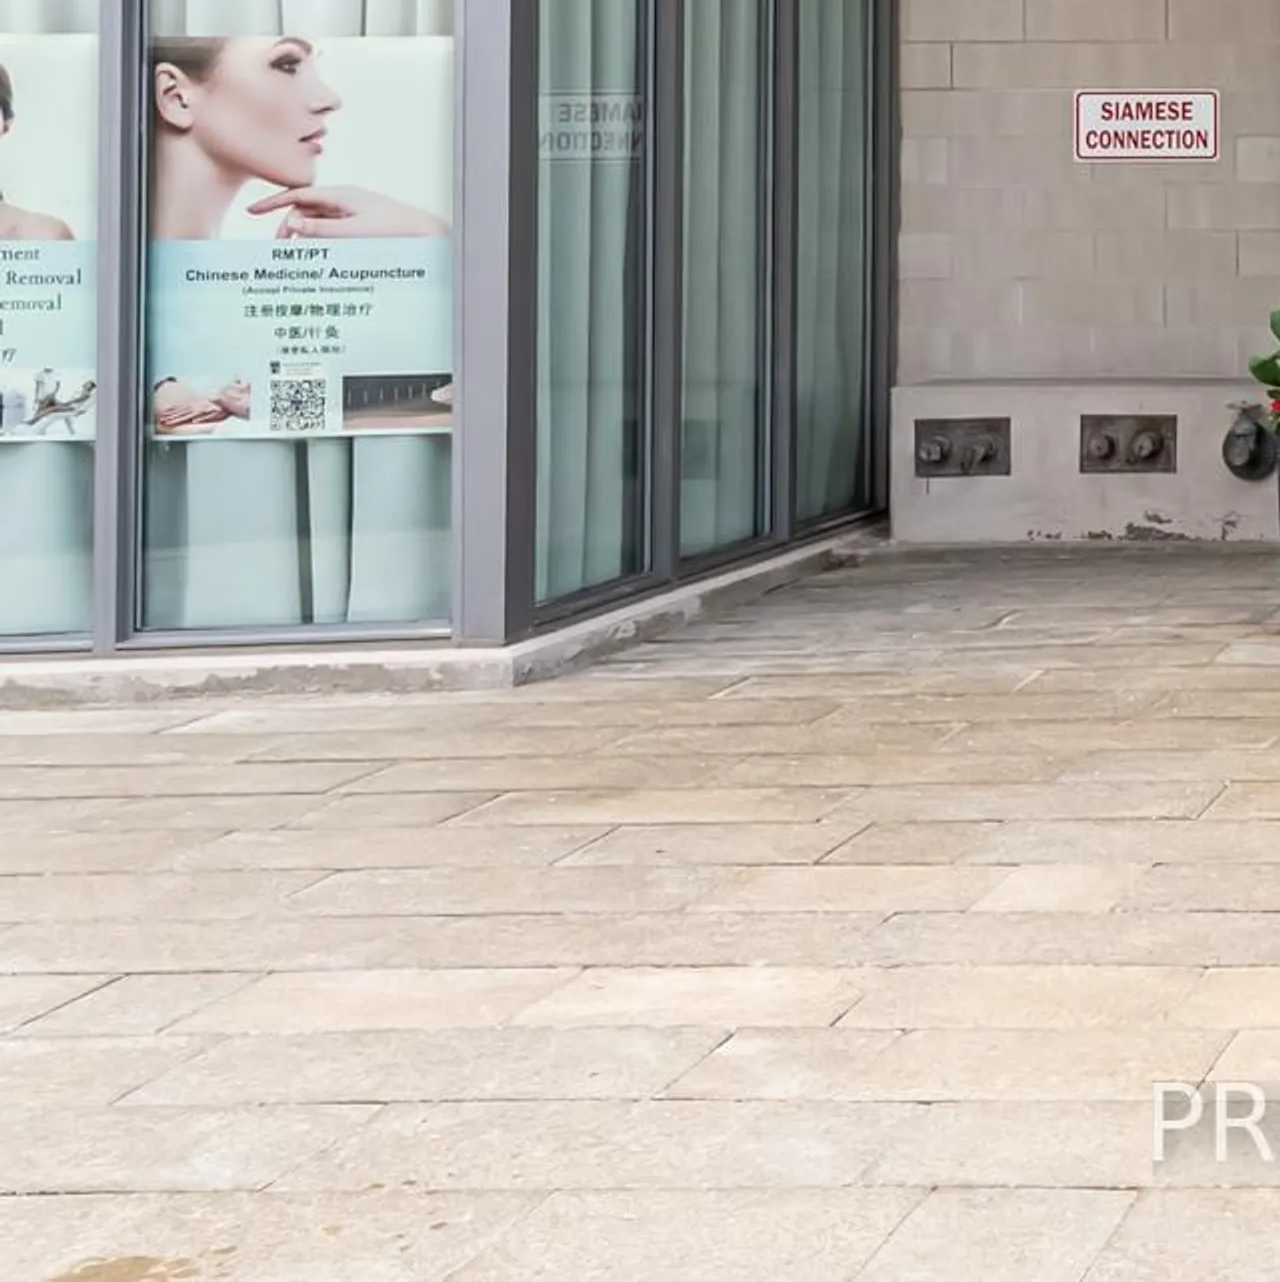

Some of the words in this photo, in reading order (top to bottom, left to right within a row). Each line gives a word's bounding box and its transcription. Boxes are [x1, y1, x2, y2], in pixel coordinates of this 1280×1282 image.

[1101, 102, 1193, 121] SIAMESE
[1086, 129, 1208, 149] CONNECTION
[271, 248, 329, 260] RMT/PT
[6, 269, 82, 285] Removal
[185, 269, 249, 282] Chinese
[253, 267, 323, 281] Medicine/
[328, 267, 426, 282] Acupuncture
